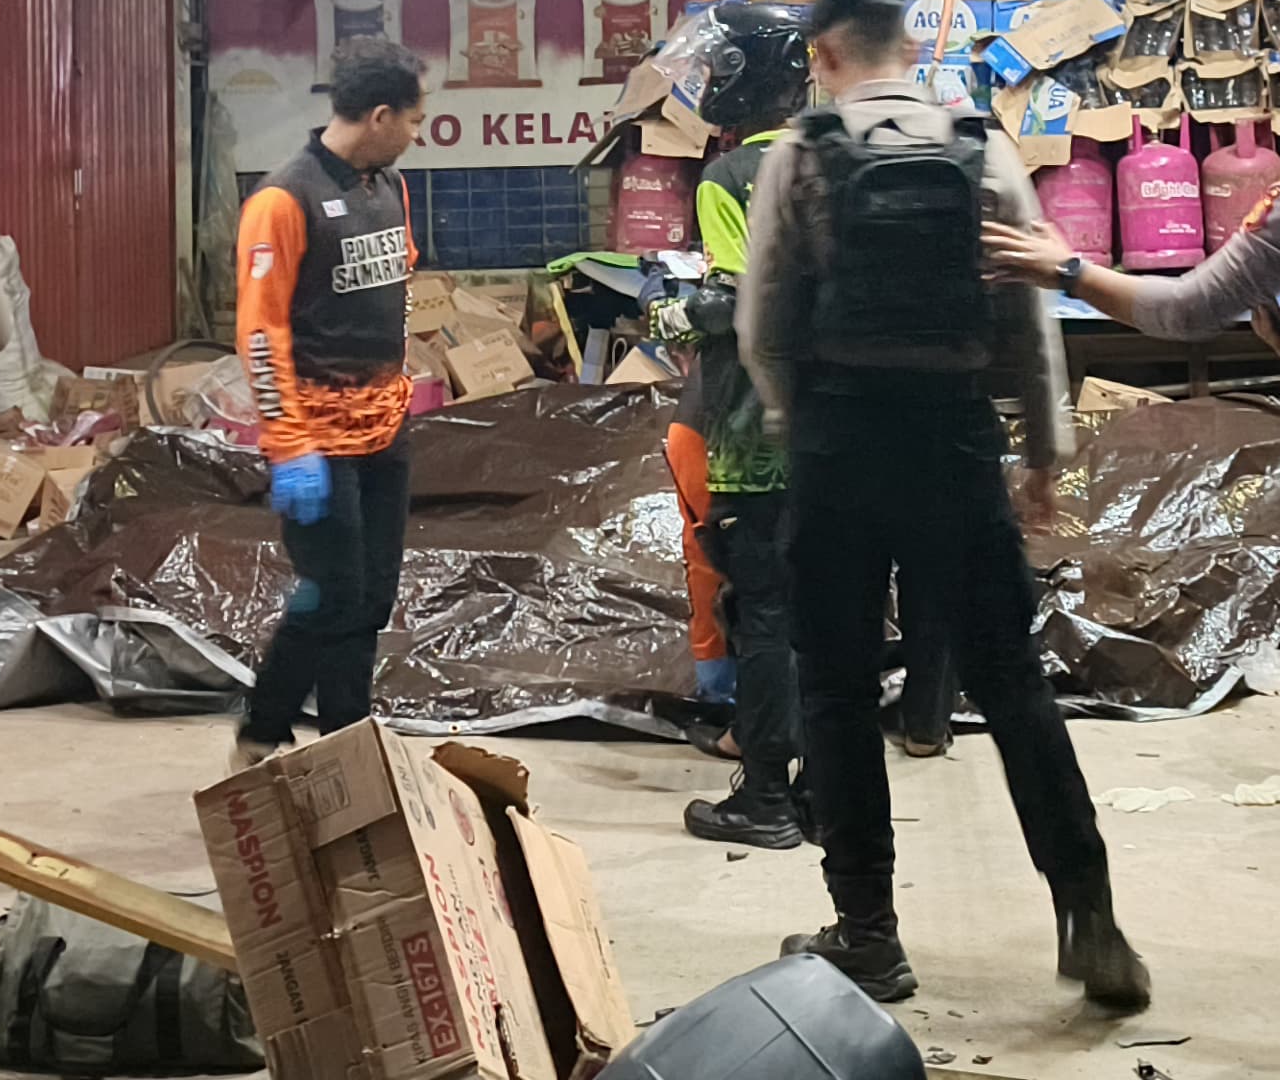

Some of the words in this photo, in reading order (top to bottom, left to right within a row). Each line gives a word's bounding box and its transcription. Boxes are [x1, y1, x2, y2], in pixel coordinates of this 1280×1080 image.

[913, 11, 967, 29] AQA
[414, 114, 462, 147] KO
[1141, 180, 1181, 200] Bright
[223, 788, 284, 929] MASPION
[423, 852, 486, 1050] MASPION
